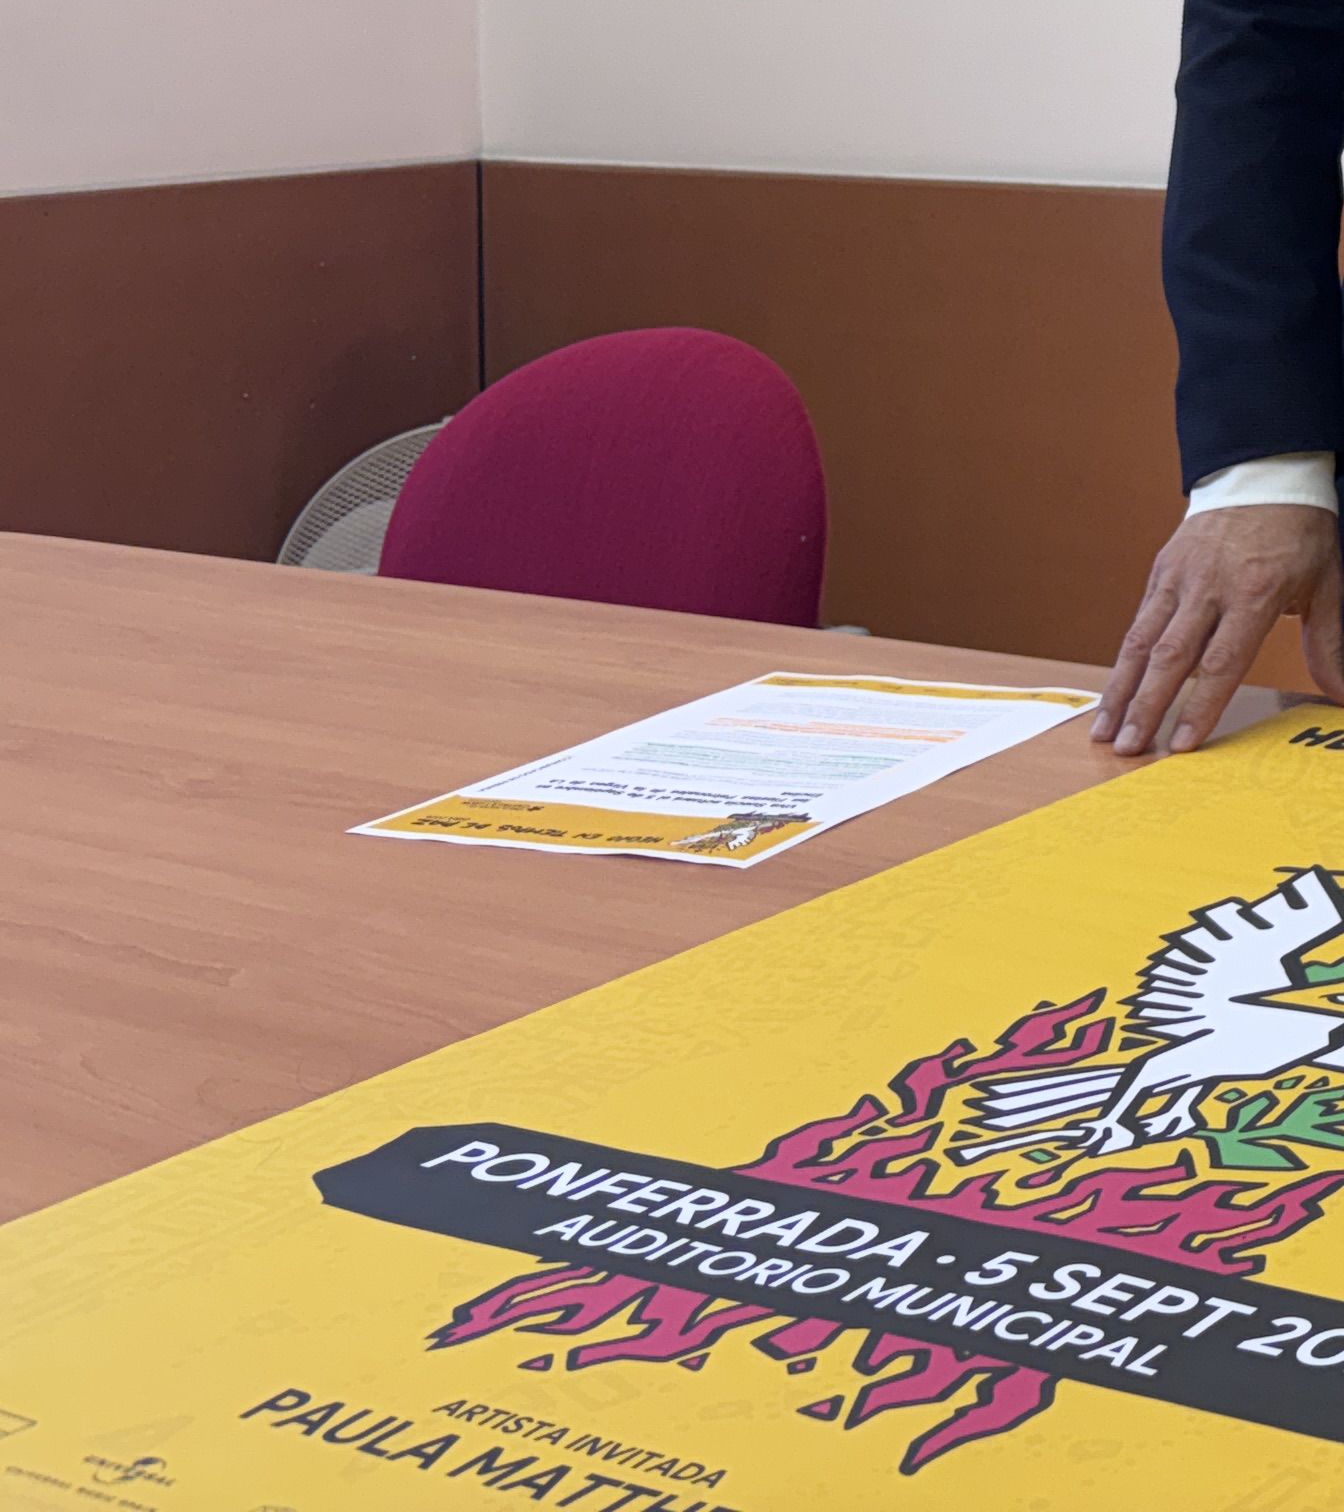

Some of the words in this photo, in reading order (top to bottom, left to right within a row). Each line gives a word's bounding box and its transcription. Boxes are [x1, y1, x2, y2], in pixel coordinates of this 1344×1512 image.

[419, 1139, 930, 1268] PONFERRADA
[963, 1252, 1037, 1288] 5
[1028, 1263, 1257, 1340] SEPT
[536, 1211, 851, 1295] AUDITORIO
[842, 1284, 1174, 1378] MUNICIPAL
[240, 1387, 461, 1469] PAULA
[432, 1398, 572, 1448] ARTISTA
[564, 1434, 728, 1489] INVITADA
